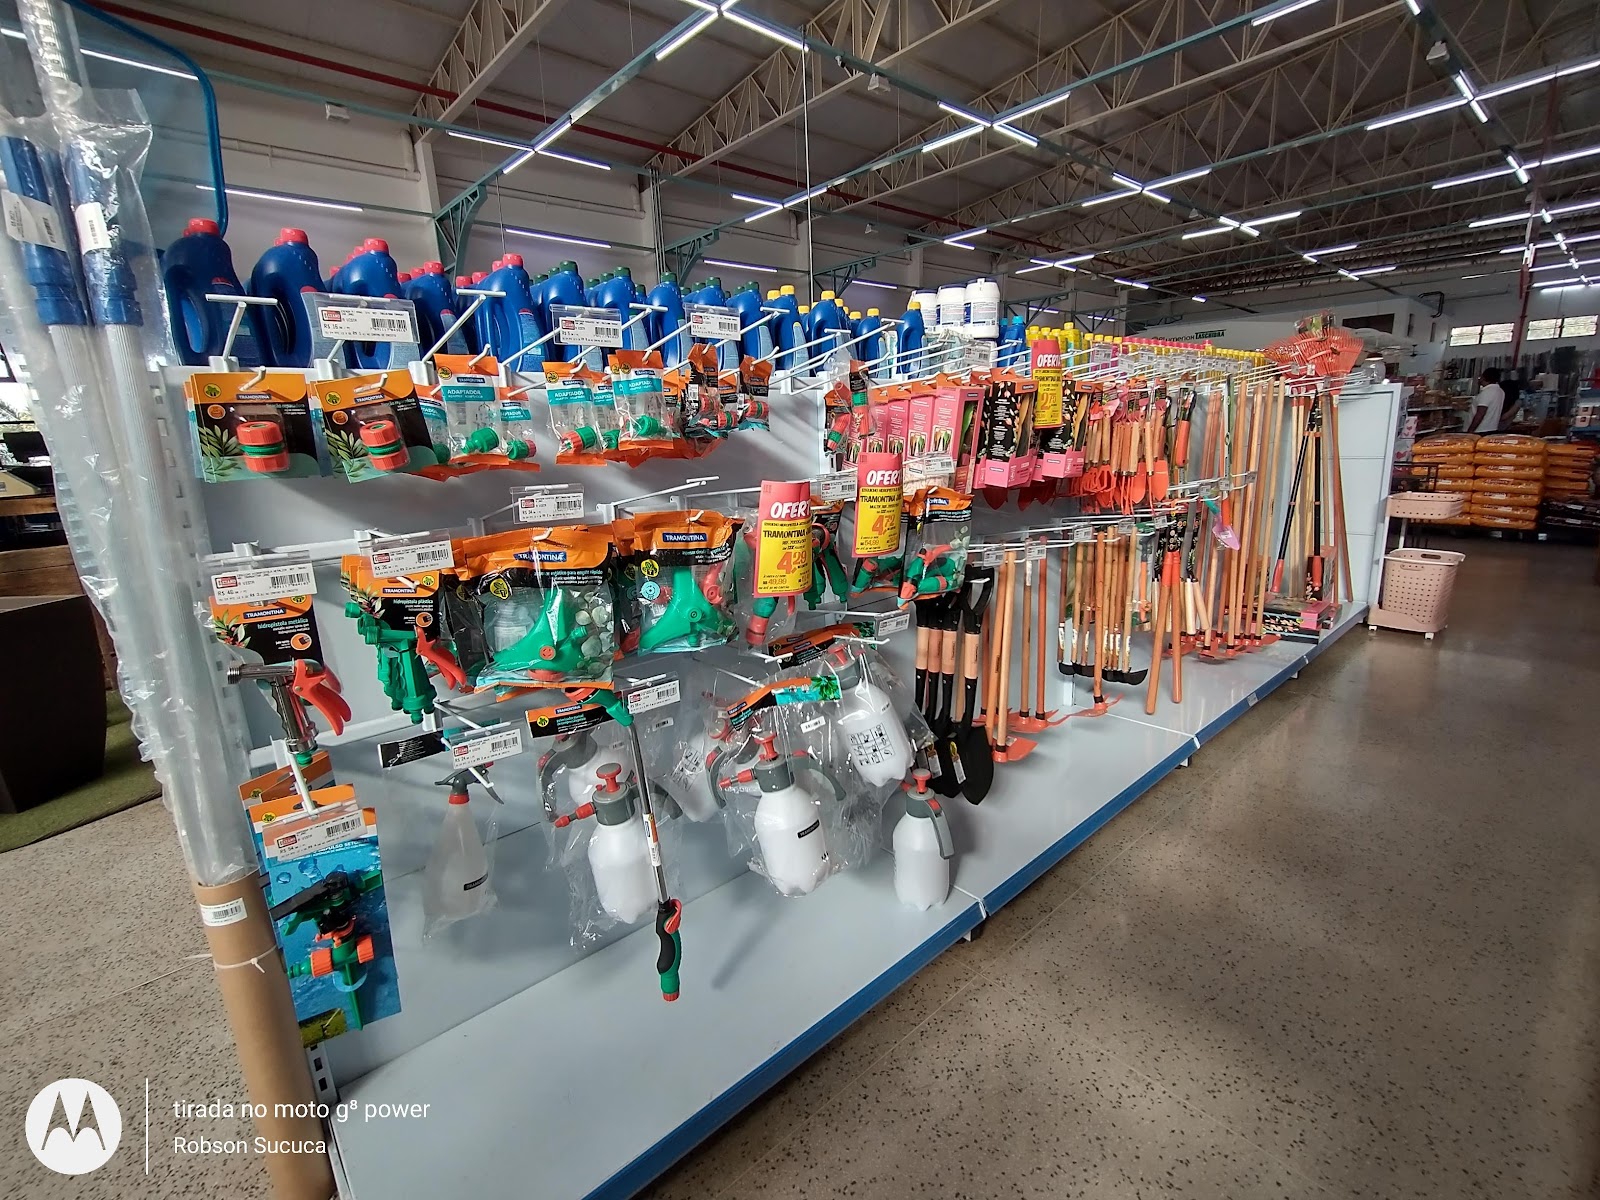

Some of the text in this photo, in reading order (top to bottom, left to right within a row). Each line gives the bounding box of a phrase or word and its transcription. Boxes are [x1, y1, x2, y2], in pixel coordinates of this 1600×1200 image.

[770, 499, 810, 519] OFERT
[763, 528, 806, 539] TRAMONTINA
[245, 609, 284, 618] TRAMONTINA
[257, 618, 308, 630] hidropistola metálica
